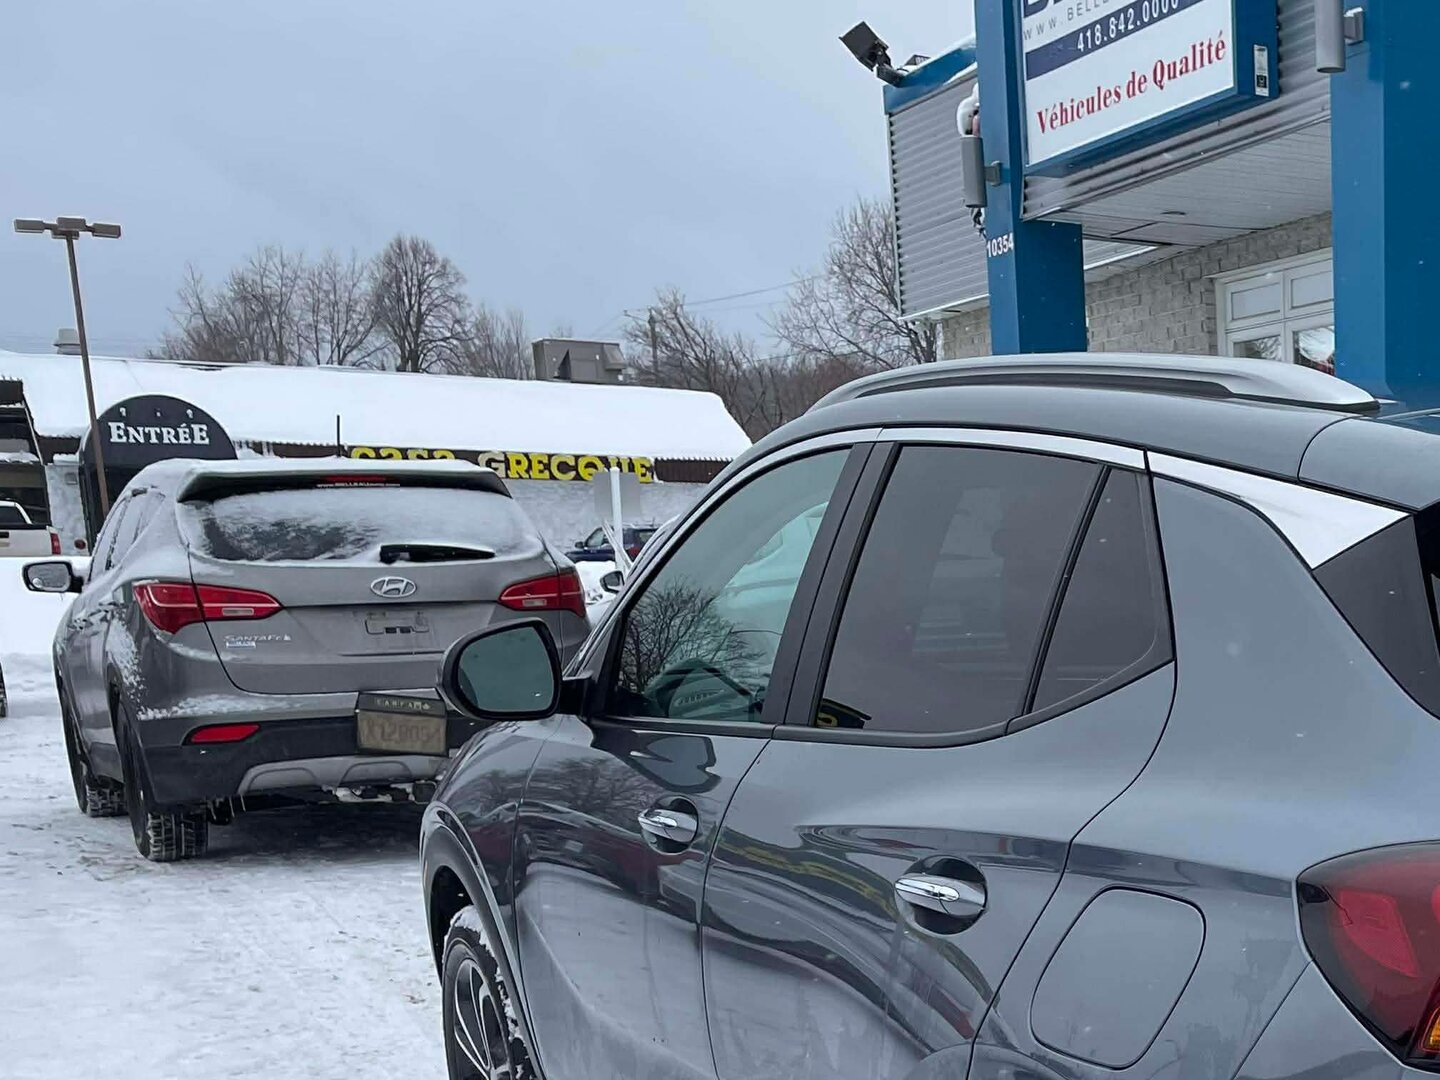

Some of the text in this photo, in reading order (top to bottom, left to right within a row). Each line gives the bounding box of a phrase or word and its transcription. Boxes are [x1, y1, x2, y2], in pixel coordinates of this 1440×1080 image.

[1036, 84, 1121, 135] Véhicules
[1125, 70, 1148, 99] de
[1152, 30, 1226, 91] Qualité
[986, 232, 1014, 258] 10354
[107, 421, 210, 445] ENTRÉE
